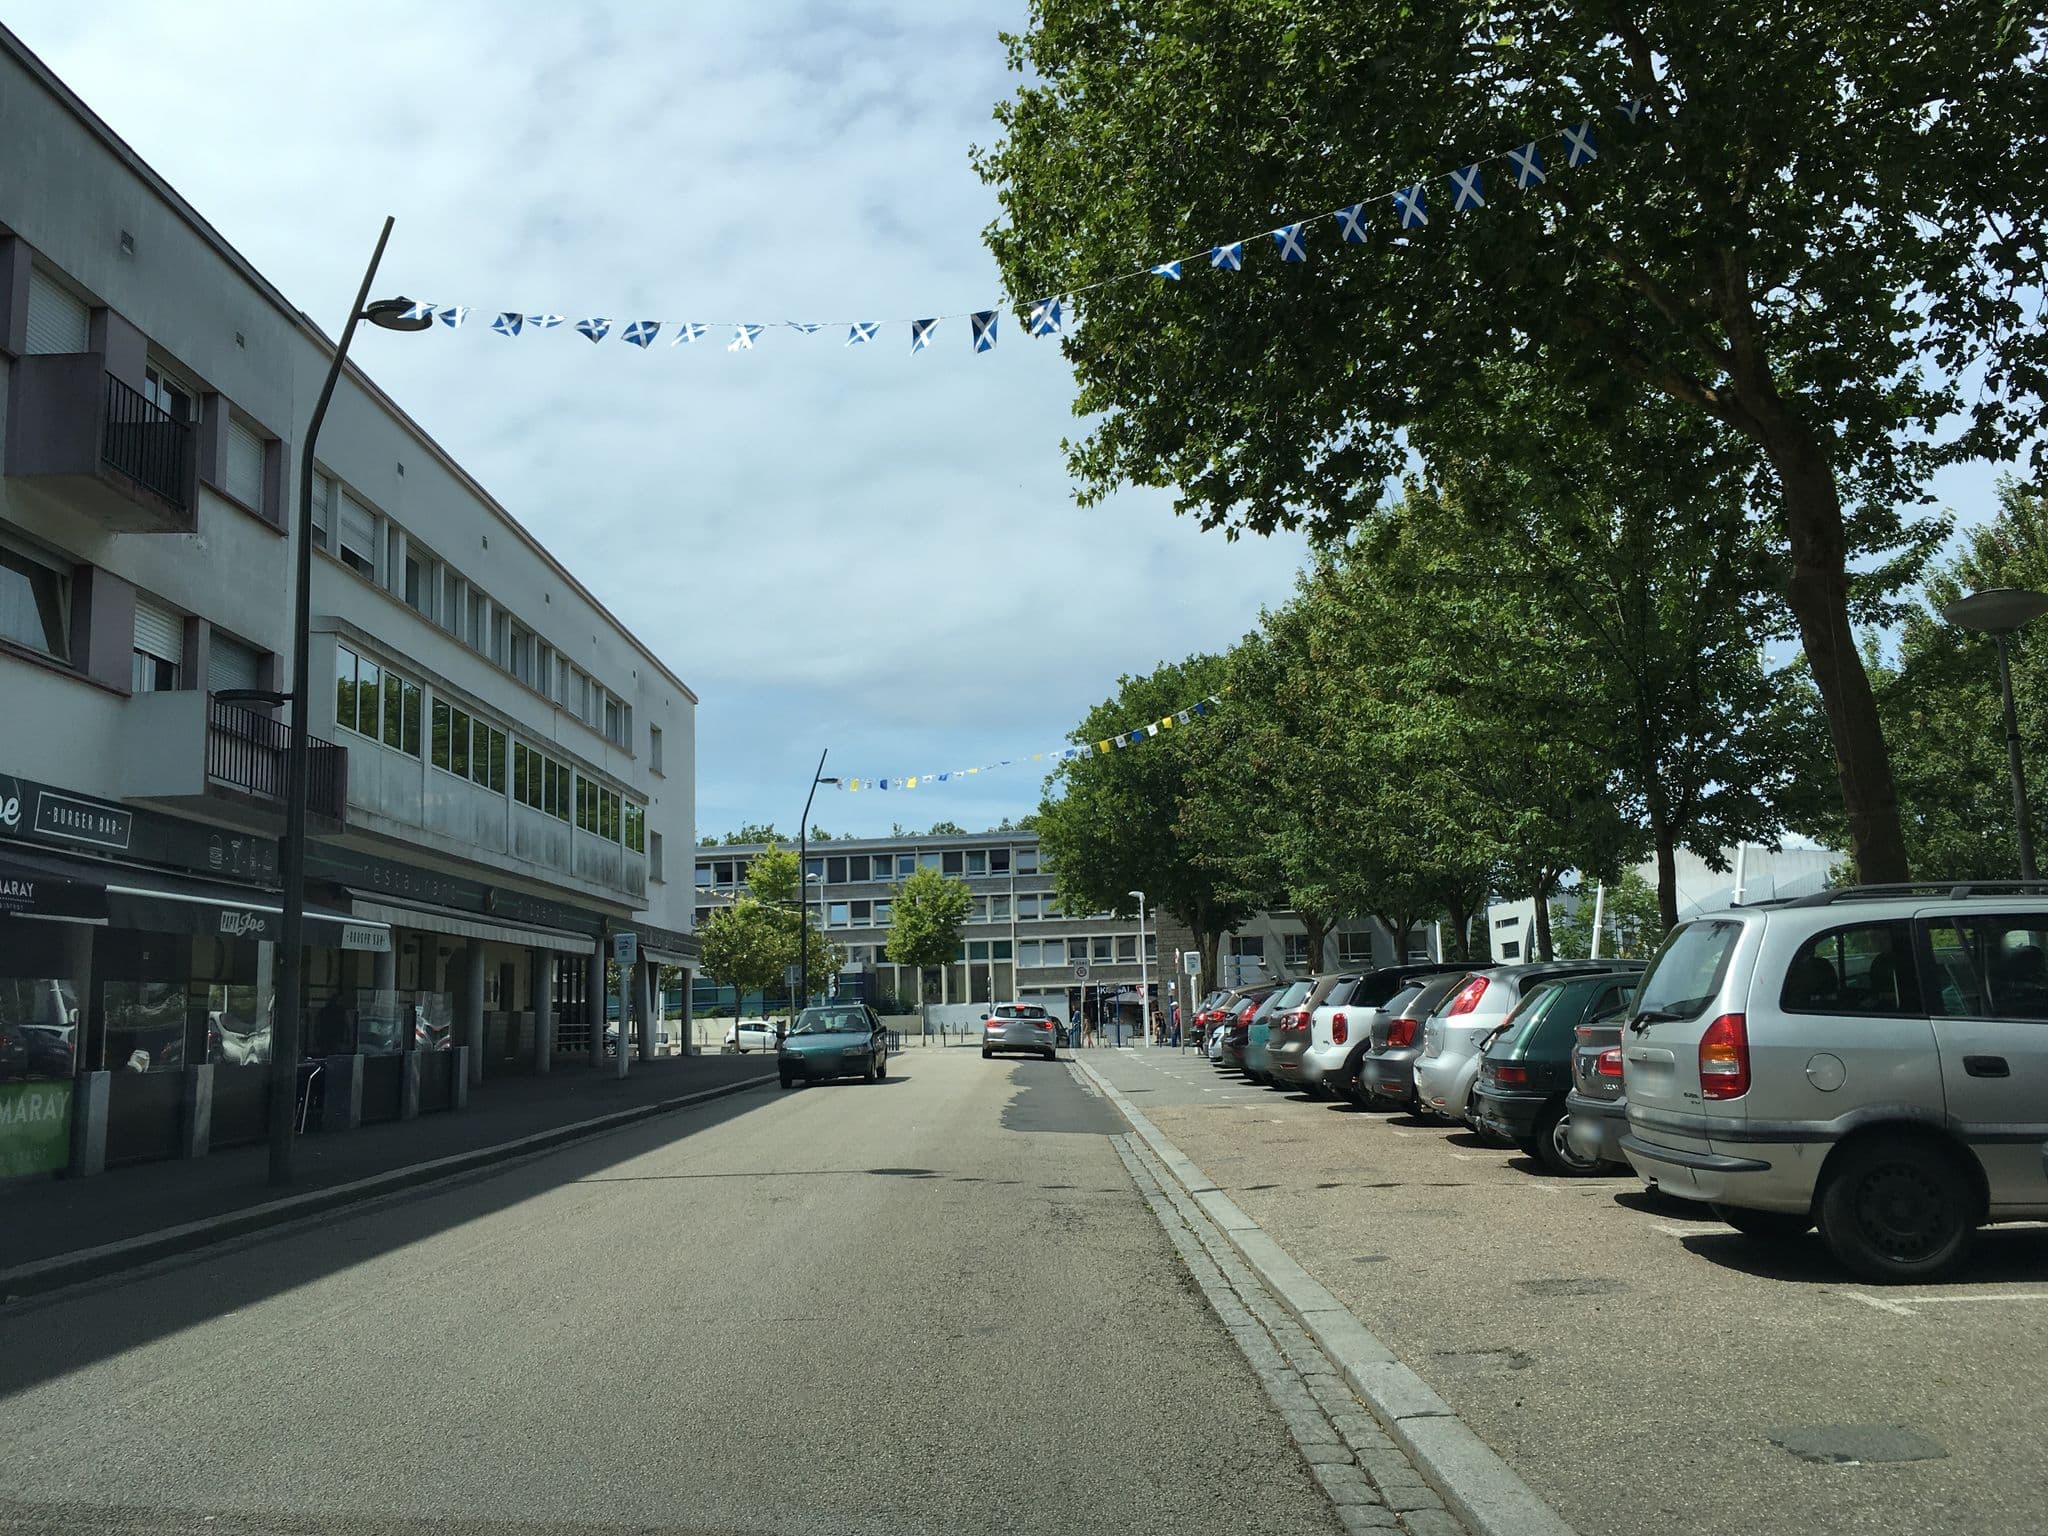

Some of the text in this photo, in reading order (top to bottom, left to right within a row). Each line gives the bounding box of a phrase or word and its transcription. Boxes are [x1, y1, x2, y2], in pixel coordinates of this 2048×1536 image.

[53, 806, 117, 835] BURGER BAR
[0, 880, 34, 897] ARAY
[236, 912, 266, 936] Joe
